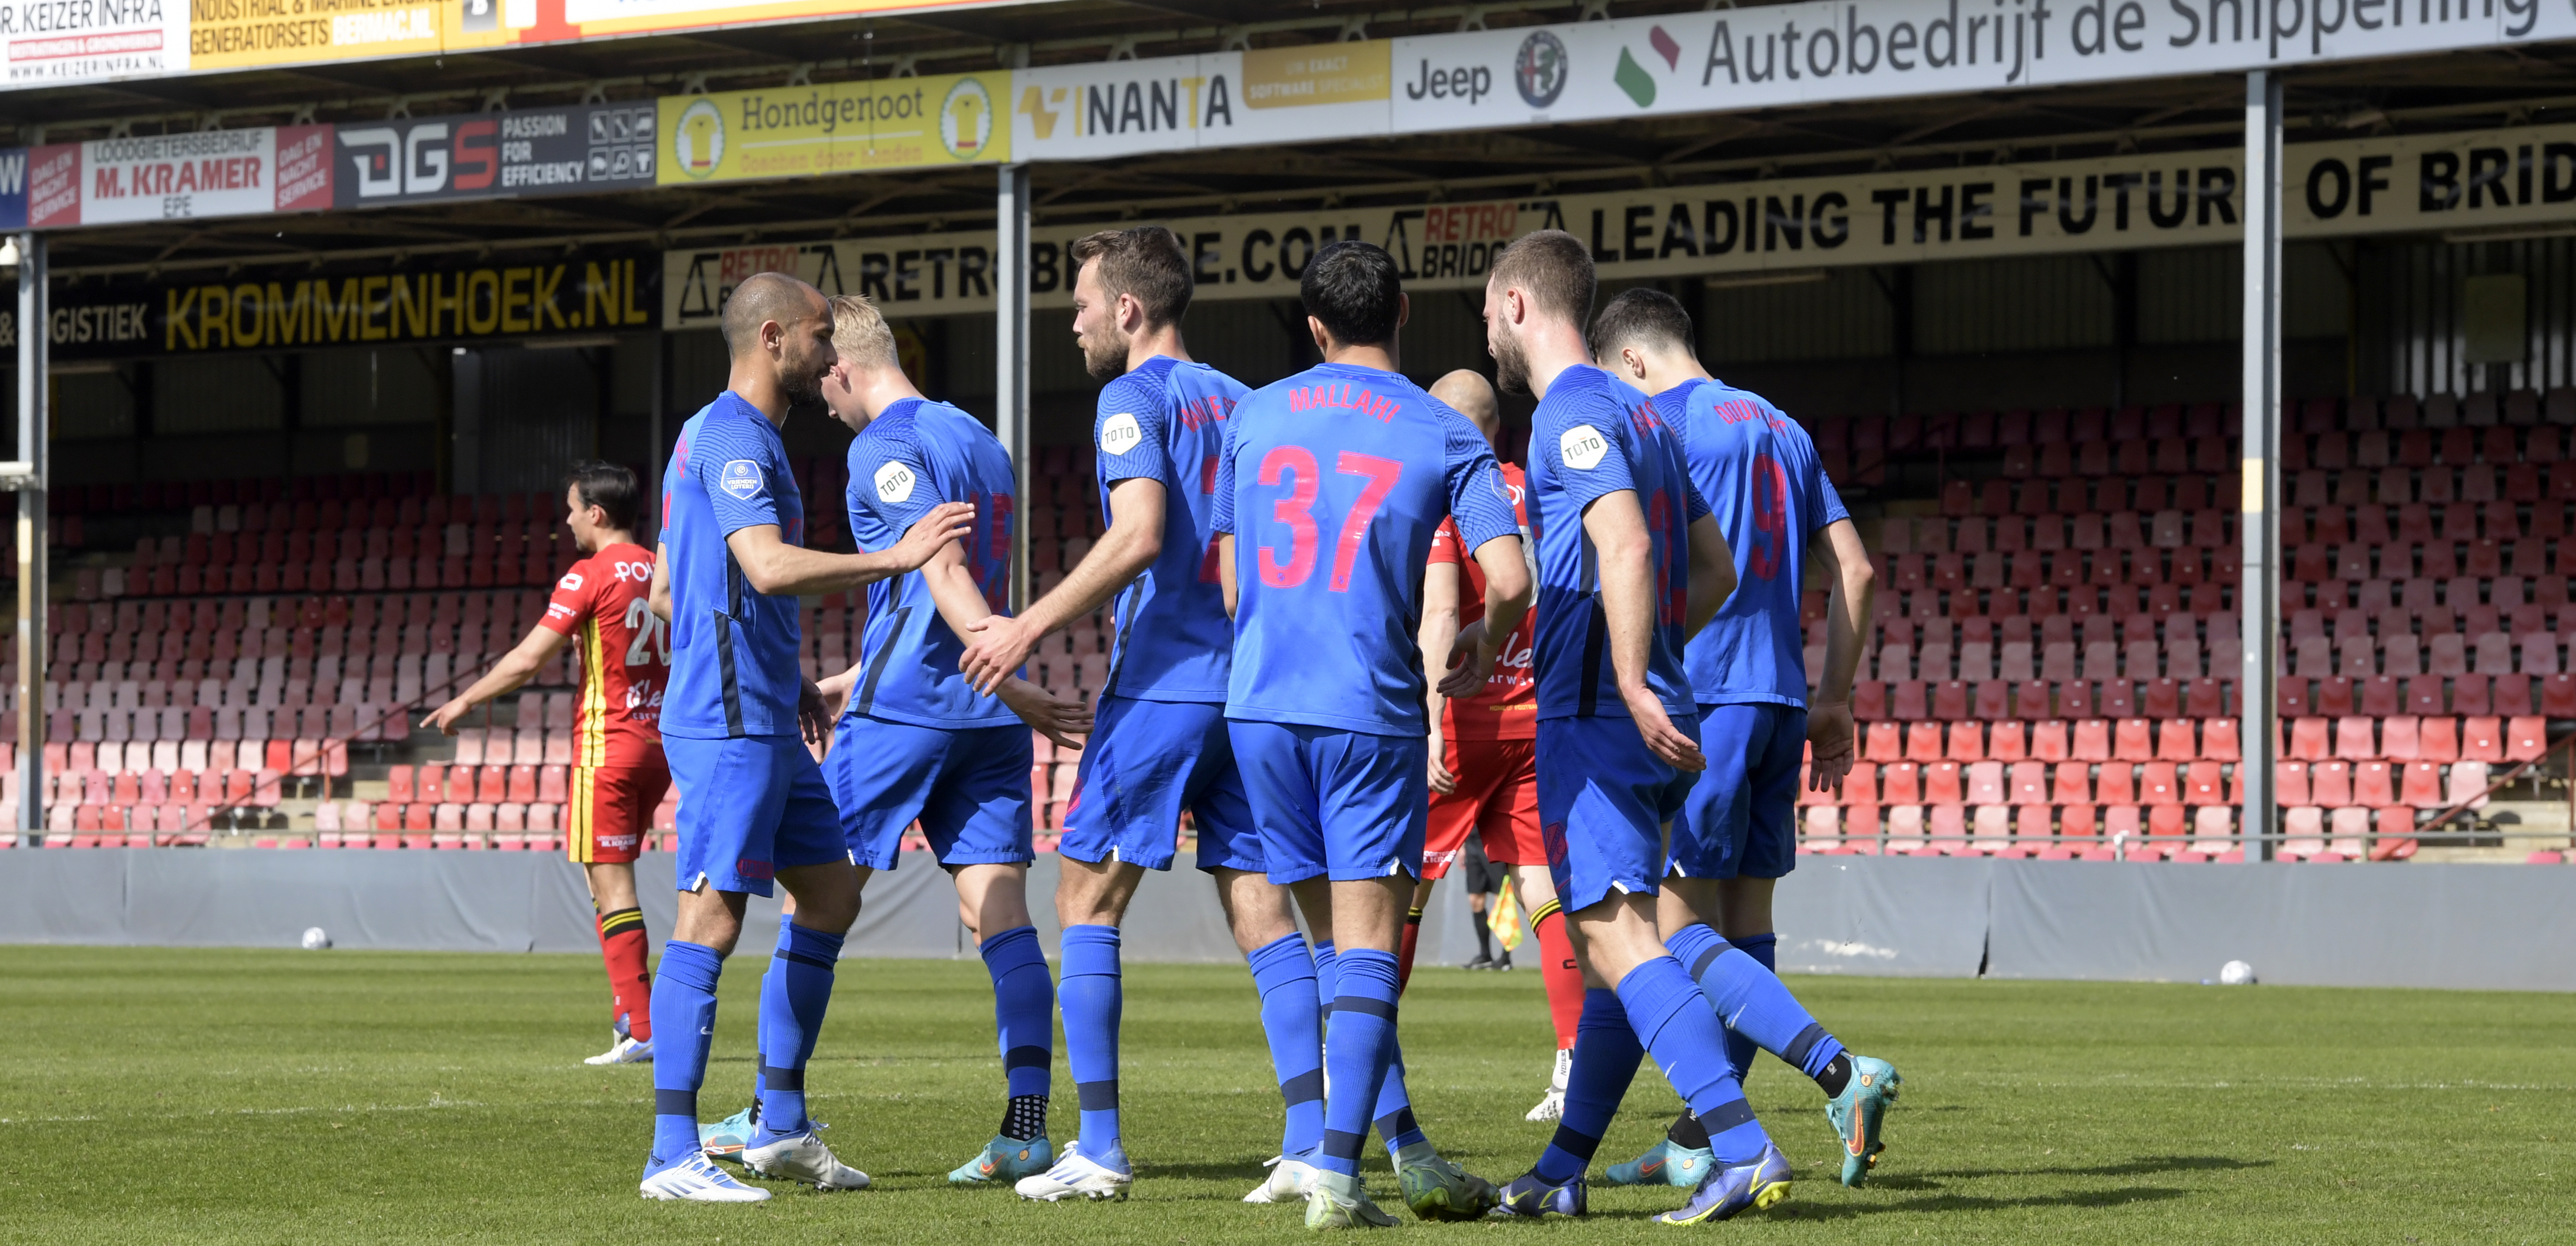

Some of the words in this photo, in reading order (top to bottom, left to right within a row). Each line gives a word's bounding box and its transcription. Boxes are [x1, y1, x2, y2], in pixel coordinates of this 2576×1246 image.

[23, 0, 93, 32] KEIZER
[99, 0, 163, 26] INFRA
[190, 19, 328, 55] GENERATORSETS
[332, 9, 435, 47] BERMAC.NL
[1702, 0, 2051, 86] Autobedrijf
[2071, 0, 2145, 56] de
[1250, 79, 1315, 100] SOFTWARE
[1407, 59, 1492, 105] Jeep
[502, 114, 567, 139] PASSION
[741, 86, 924, 133] Hondgenoot
[57, 149, 73, 173] EN
[93, 130, 263, 163] LOODGIETERSBEDRIJF
[305, 130, 323, 154] EN
[339, 121, 498, 198] DGS
[502, 141, 532, 163] FOR
[95, 167, 126, 199] M.
[132, 157, 261, 197] KRAMER
[278, 168, 327, 208] SERVICE
[501, 160, 585, 188] EFFICIENCY
[31, 186, 76, 225] SERVICE
[163, 195, 193, 218] EPE
[1590, 191, 1849, 263] LEADING
[1871, 181, 1995, 246] THE
[2018, 166, 2245, 237] FUTUR
[2306, 155, 2393, 220] OF
[2419, 142, 2576, 213] BRID
[1425, 203, 1517, 243] RETRO
[48, 303, 148, 345] GISTIEK
[165, 258, 648, 351] KROMMENHOEK.NL
[1289, 383, 1401, 424] MALLAHI
[1104, 426, 1135, 444] TOTO
[1564, 437, 1600, 460] TOTO
[880, 470, 908, 496] TOTO
[1257, 445, 1404, 593] 37
[1751, 452, 1787, 582] 9
